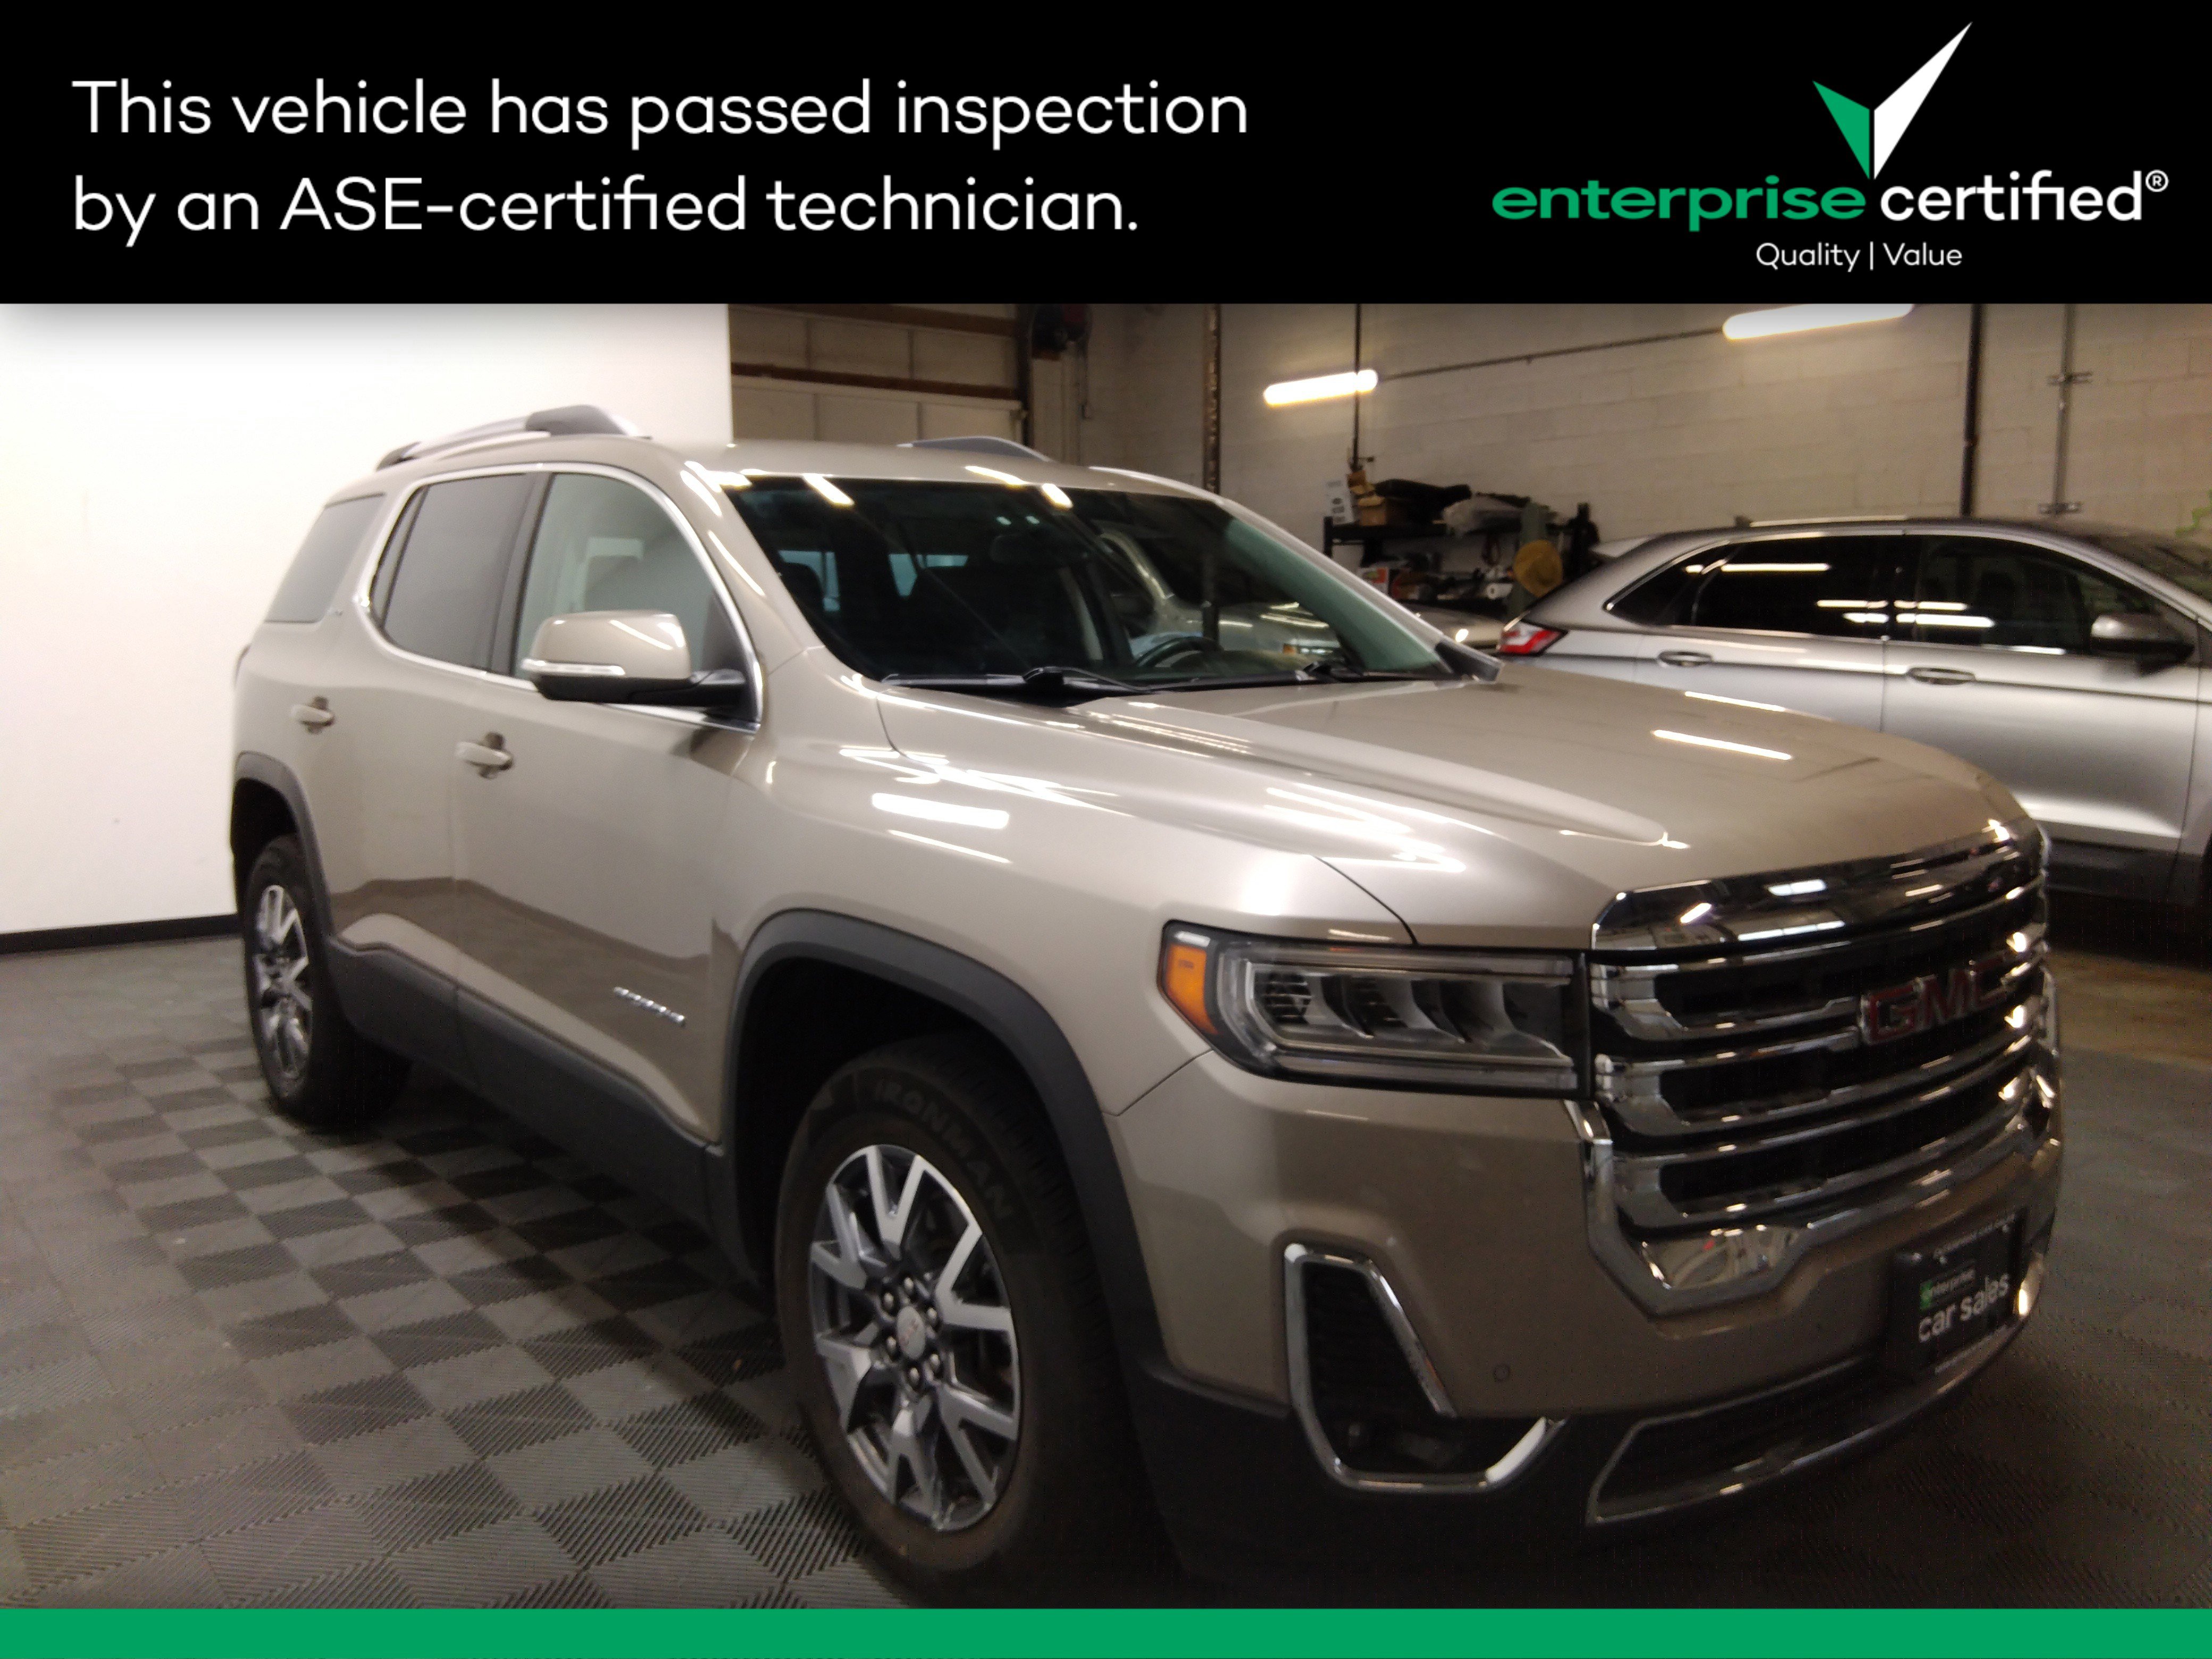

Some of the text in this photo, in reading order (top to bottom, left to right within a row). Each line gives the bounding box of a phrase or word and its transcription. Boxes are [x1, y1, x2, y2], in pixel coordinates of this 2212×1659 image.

[1858, 951, 2010, 1045] GMC
[874, 1078, 1013, 1218] IRONMAN
[1918, 1304, 1957, 1343] car
[1960, 1273, 2010, 1321] sales
